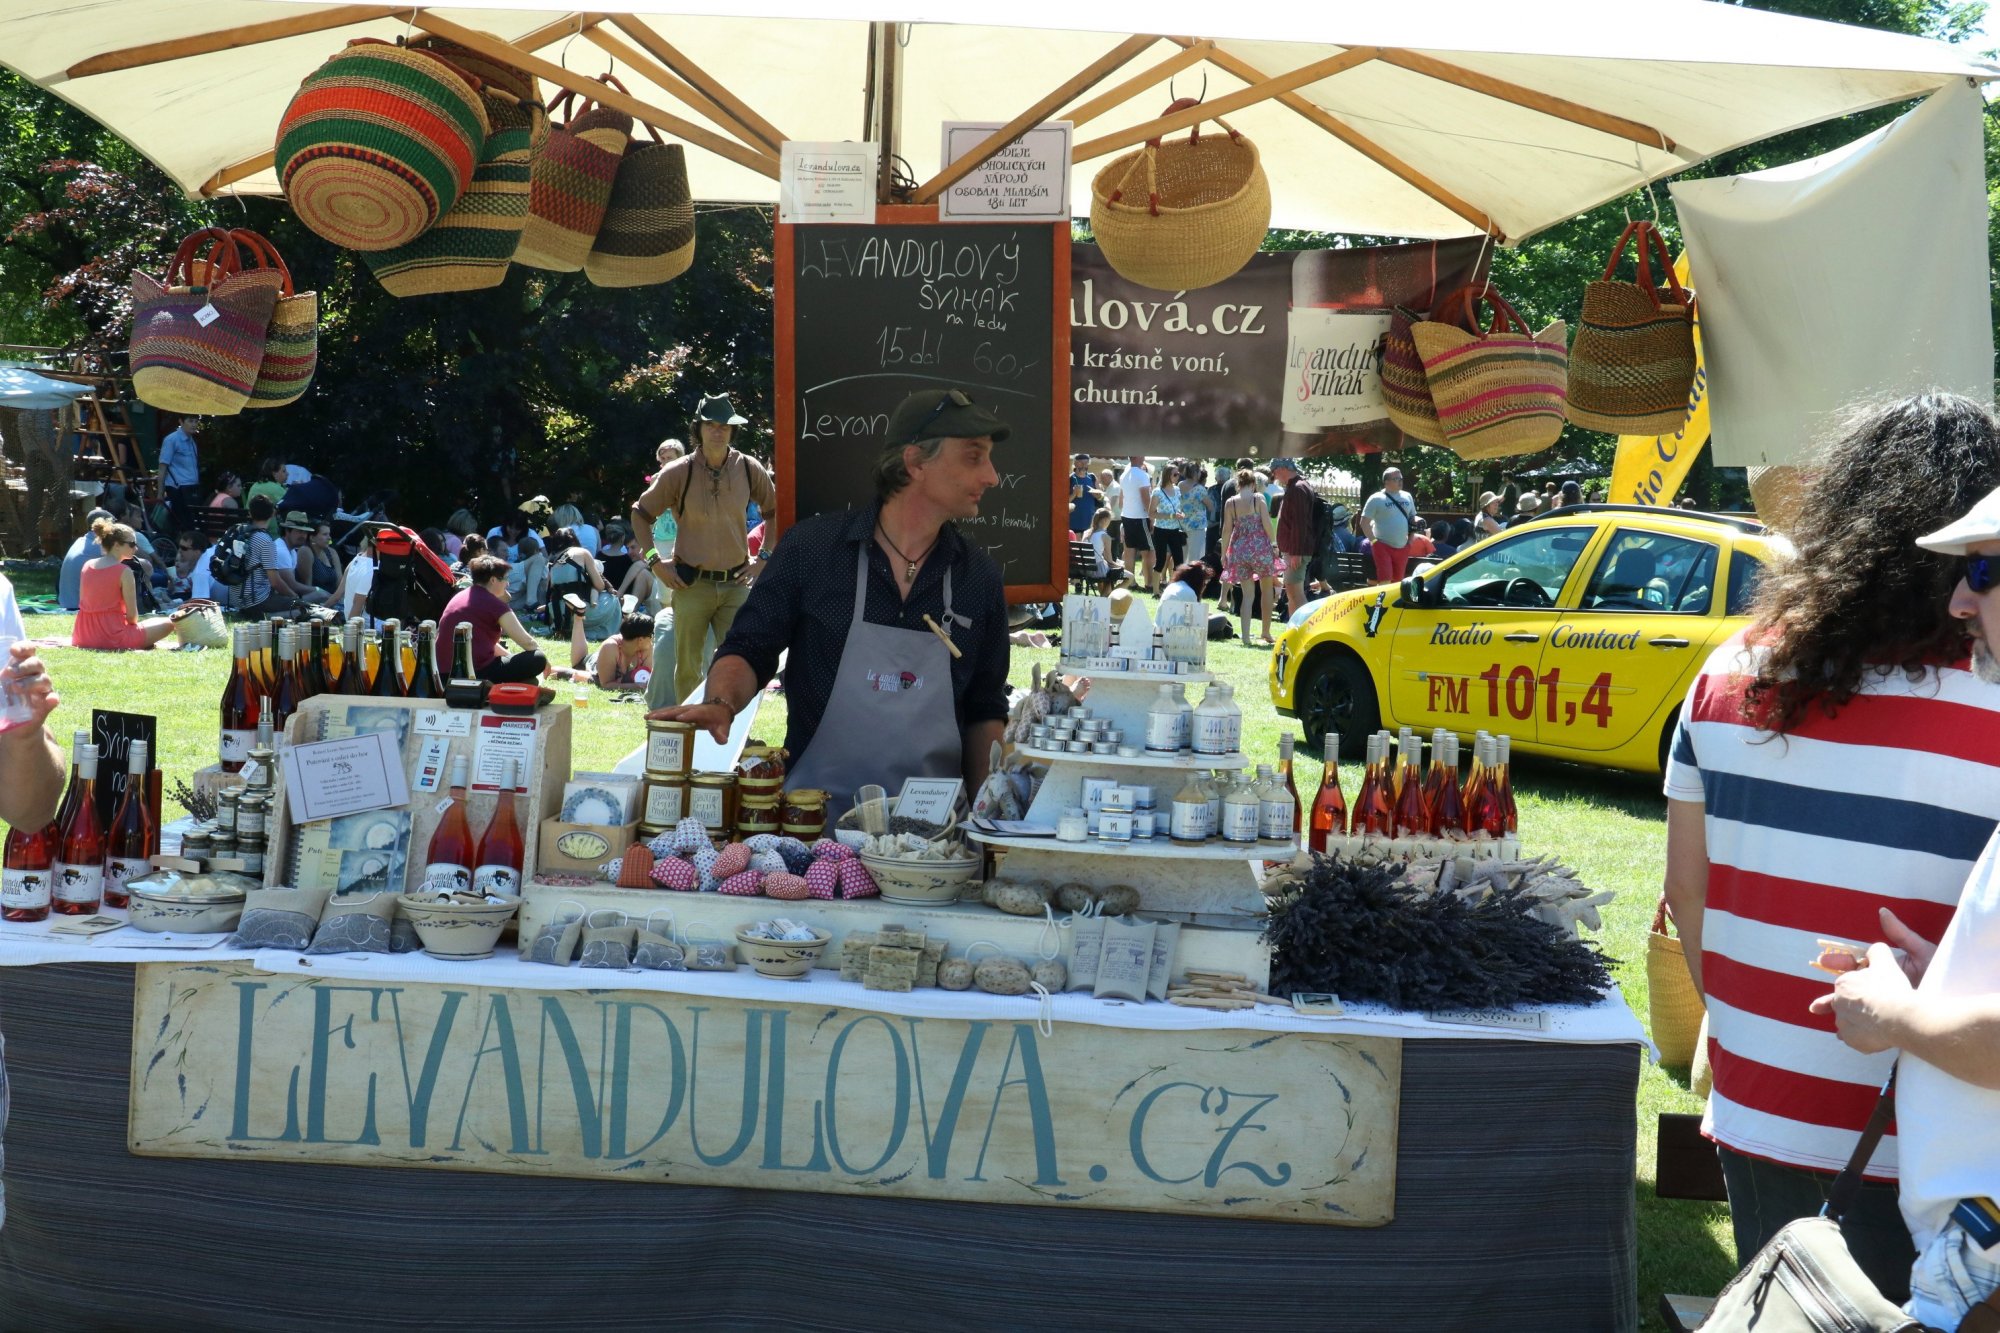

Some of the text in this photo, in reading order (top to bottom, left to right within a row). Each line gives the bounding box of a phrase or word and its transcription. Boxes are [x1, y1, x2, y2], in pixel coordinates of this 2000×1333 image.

[955, 184, 1049, 198] OSOBÁM MLADŠÍM
[1009, 198, 1028, 207] LET
[801, 231, 1020, 285] LEVANDULOVÝ
[946, 311, 1007, 331] na ledu
[1084, 343, 1229, 375] krásně voní,
[1074, 380, 1186, 407] chutná...
[801, 398, 890, 441] Levan
[1333, 595, 1365, 622] hudba
[1429, 622, 1641, 650] Radio Contact
[1427, 663, 1613, 729] FM 101,4
[228, 981, 1291, 1188] LEVANDULOVA.CZ
